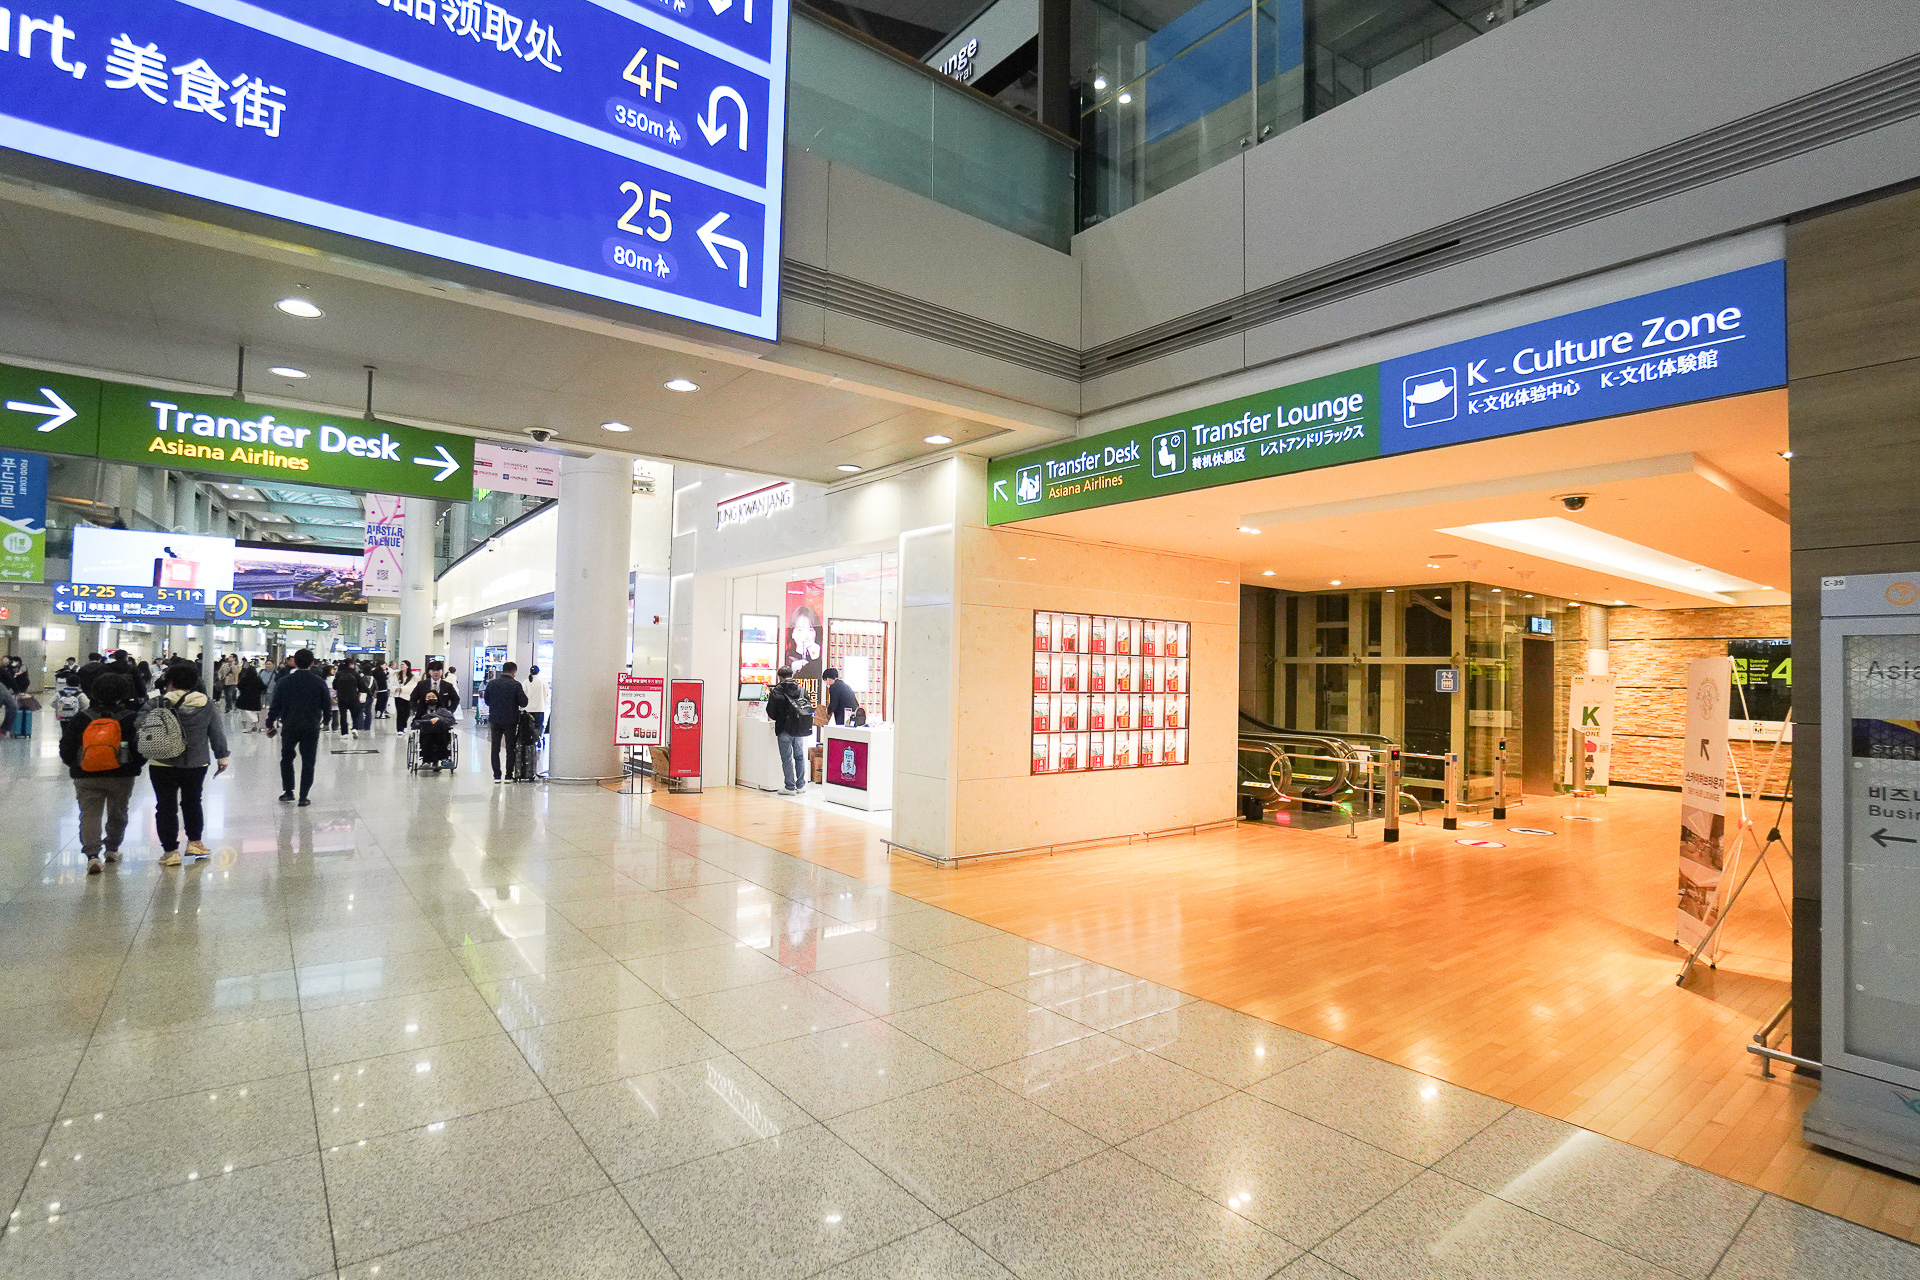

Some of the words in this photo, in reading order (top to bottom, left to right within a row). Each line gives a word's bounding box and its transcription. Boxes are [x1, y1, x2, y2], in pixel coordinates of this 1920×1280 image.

[105, 32, 288, 138] 美食街
[622, 46, 681, 104] 4F
[614, 104, 665, 139] 350m
[617, 180, 674, 243] 25
[613, 245, 653, 273] 80m
[1467, 358, 1488, 387] K
[1512, 328, 1635, 377] Culture
[1640, 305, 1743, 348] Zone
[1468, 378, 1581, 415] K-文化体验中心
[1600, 348, 1719, 389] K-文化体験館
[150, 400, 312, 450] Transfer
[319, 424, 402, 462] Desk
[1192, 412, 1271, 446] Transfer
[1276, 391, 1364, 428] Lounge
[148, 436, 226, 461] Asiana
[229, 445, 310, 471] Airlines
[1260, 424, 1365, 458] レストアンドリラックス
[20, 459, 28, 476] FOOD
[1045, 450, 1101, 480] Transfer
[1103, 440, 1140, 464] Desk
[1048, 482, 1081, 499] Asiana
[1083, 473, 1123, 493] Airlines
[716, 506, 738, 530] JUNG
[738, 498, 765, 524] KWAN
[764, 489, 792, 518] JANG
[366, 524, 404, 537] AIRSTAR
[367, 535, 401, 547] AVENUE
[71, 584, 116, 598] 12-25
[120, 591, 145, 600] Gates
[157, 589, 192, 601] 5-11
[1823, 579, 1845, 587] C-39
[1581, 706, 1601, 727] K
[1872, 744, 1916, 755] STAR
